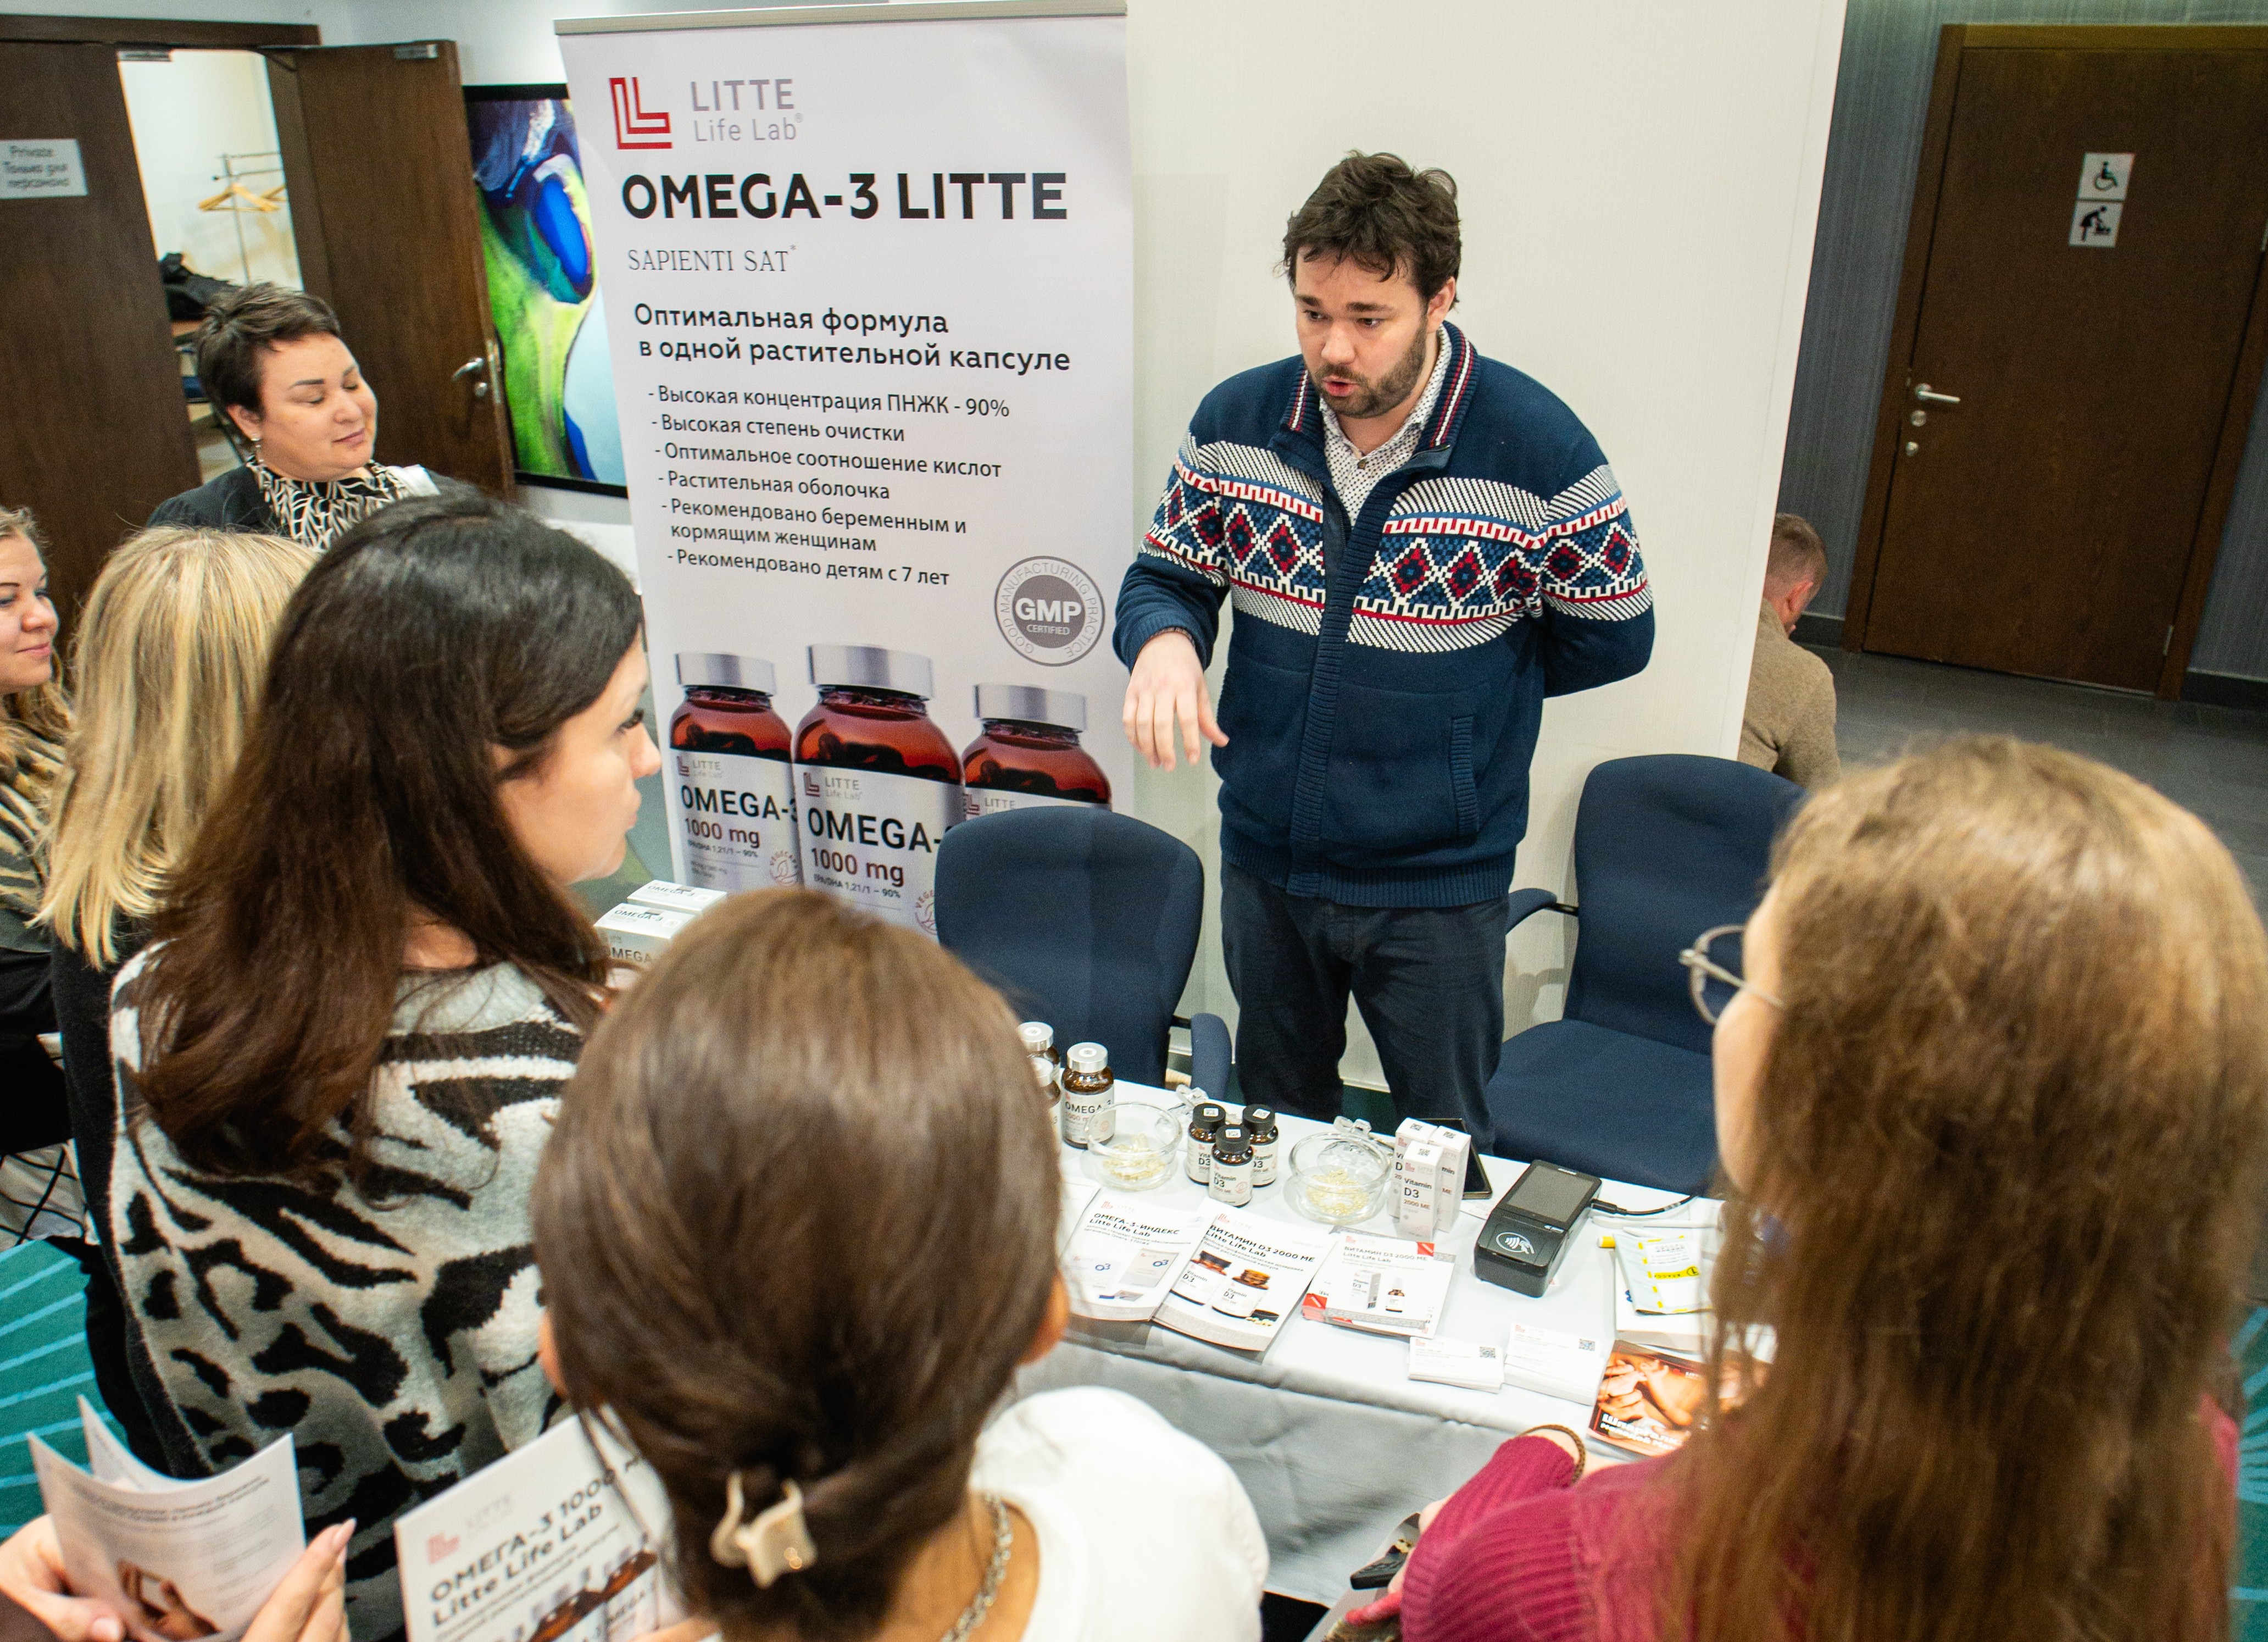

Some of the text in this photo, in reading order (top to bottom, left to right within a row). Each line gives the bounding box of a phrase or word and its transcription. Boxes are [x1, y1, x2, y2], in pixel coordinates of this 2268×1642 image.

[690, 77, 794, 112] LITTE
[693, 118, 741, 142] Life
[621, 173, 1068, 220] OMEGA-3 LITTE
[627, 249, 734, 272] SAPIENTI
[633, 303, 949, 336] Оптимальная формула
[638, 337, 1070, 375] в одной растительной капсуле
[658, 385, 737, 405] Высокая
[743, 390, 881, 413] концентрация
[886, 393, 949, 414] ПНЖК
[965, 398, 1010, 418] 90%
[661, 414, 741, 434] Высокая
[746, 419, 820, 439] степень
[825, 423, 904, 442] очистки
[664, 442, 792, 465] Оптимальное
[797, 451, 927, 473] соотношение
[932, 459, 1002, 478] кислот
[668, 470, 792, 494] Растительная
[798, 479, 890, 499] оболочка
[671, 498, 816, 524] Рекомендовано
[822, 506, 949, 534] беременным
[954, 519, 966, 534] и
[670, 524, 876, 551] кормящим женщинам
[677, 549, 821, 576] Рекомендовано
[826, 563, 883, 581] детям
[888, 567, 897, 581] с
[902, 565, 911, 583] 7
[917, 570, 949, 586] лет
[1000, 562, 1099, 658] GOOD MANUFACTURING PRACTICE
[1016, 597, 1082, 623] GMP
[1026, 624, 1070, 635] CERTIFIED
[692, 759, 721, 770] LITTE
[825, 776, 860, 790] LITTE
[825, 790, 842, 798] Life
[985, 797, 1015, 809] LITTE
[685, 818, 760, 849] 1000 mg
[807, 807, 953, 853] OMEGA-
[811, 847, 904, 888] 1000 mg
[647, 884, 696, 897] OMEGA-3
[845, 882, 870, 894] 1,21/1
[882, 888, 902, 899] 90%
[614, 909, 664, 922] OMEGA-3
[1213, 1177, 1226, 1188] D3
[1214, 1172, 1237, 1181] Vitamin
[1404, 1177, 1432, 1190] Vitamin
[1403, 1199, 1419, 1208] 2000
[1404, 1187, 1420, 1199] D3
[1089, 1218, 1151, 1238] Litte Life Lab
[1093, 1212, 1181, 1235] ОМЕГА-3-ИНДЕКС
[1205, 1230, 1267, 1258] Litte Life Lab
[1209, 1224, 1257, 1247] ВИТАМИН
[1258, 1244, 1271, 1252] D3
[1272, 1249, 1299, 1260] 2000
[1344, 1246, 1382, 1256] ВИТАМИН
[1182, 1273, 1195, 1283] D3
[1223, 1291, 1235, 1300] D3
[431, 1511, 553, 1601] ОМЕГА-3
[432, 1578, 498, 1626] Litte
[504, 1539, 553, 1579] Life
[560, 1502, 603, 1541] Lab
